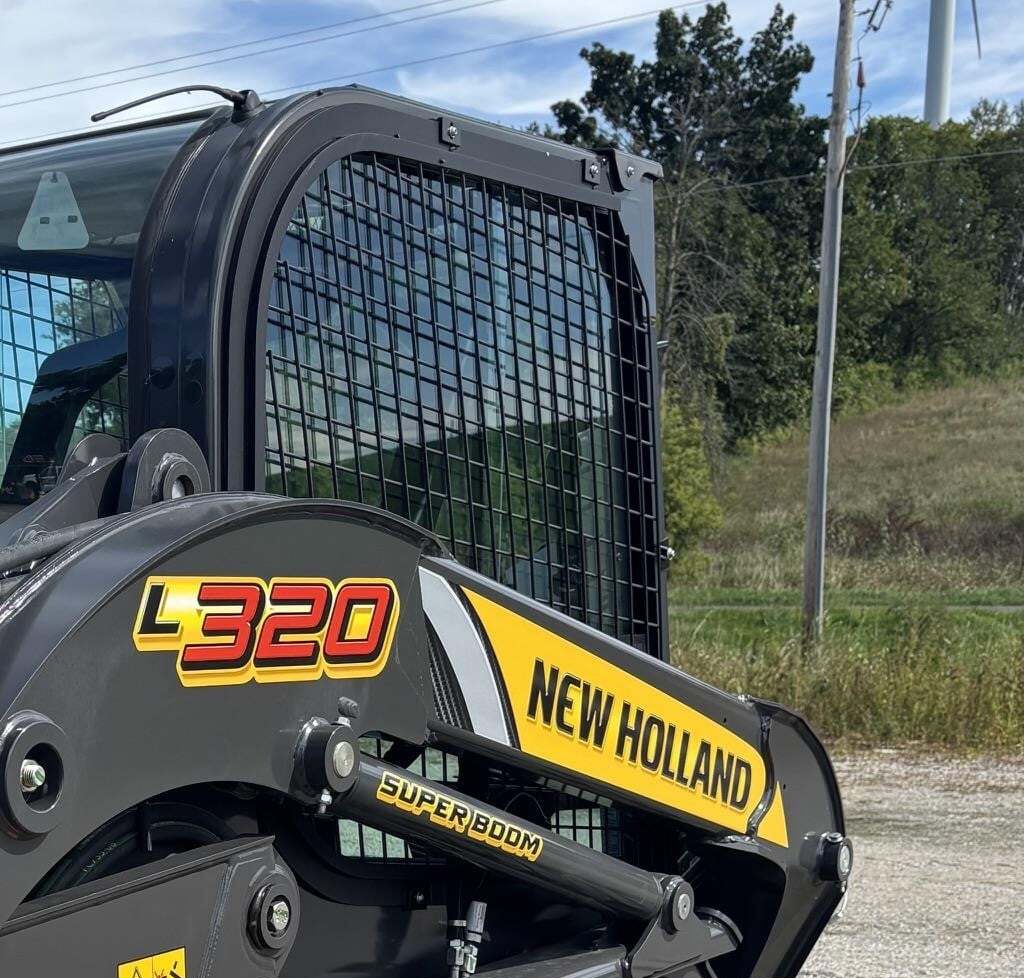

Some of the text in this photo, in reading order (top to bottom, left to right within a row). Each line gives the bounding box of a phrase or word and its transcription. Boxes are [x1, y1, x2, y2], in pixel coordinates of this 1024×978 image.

[136, 580, 397, 675] L320
[526, 657, 753, 812] NEW HOLLAND
[378, 772, 543, 860] SUPER BOOM
